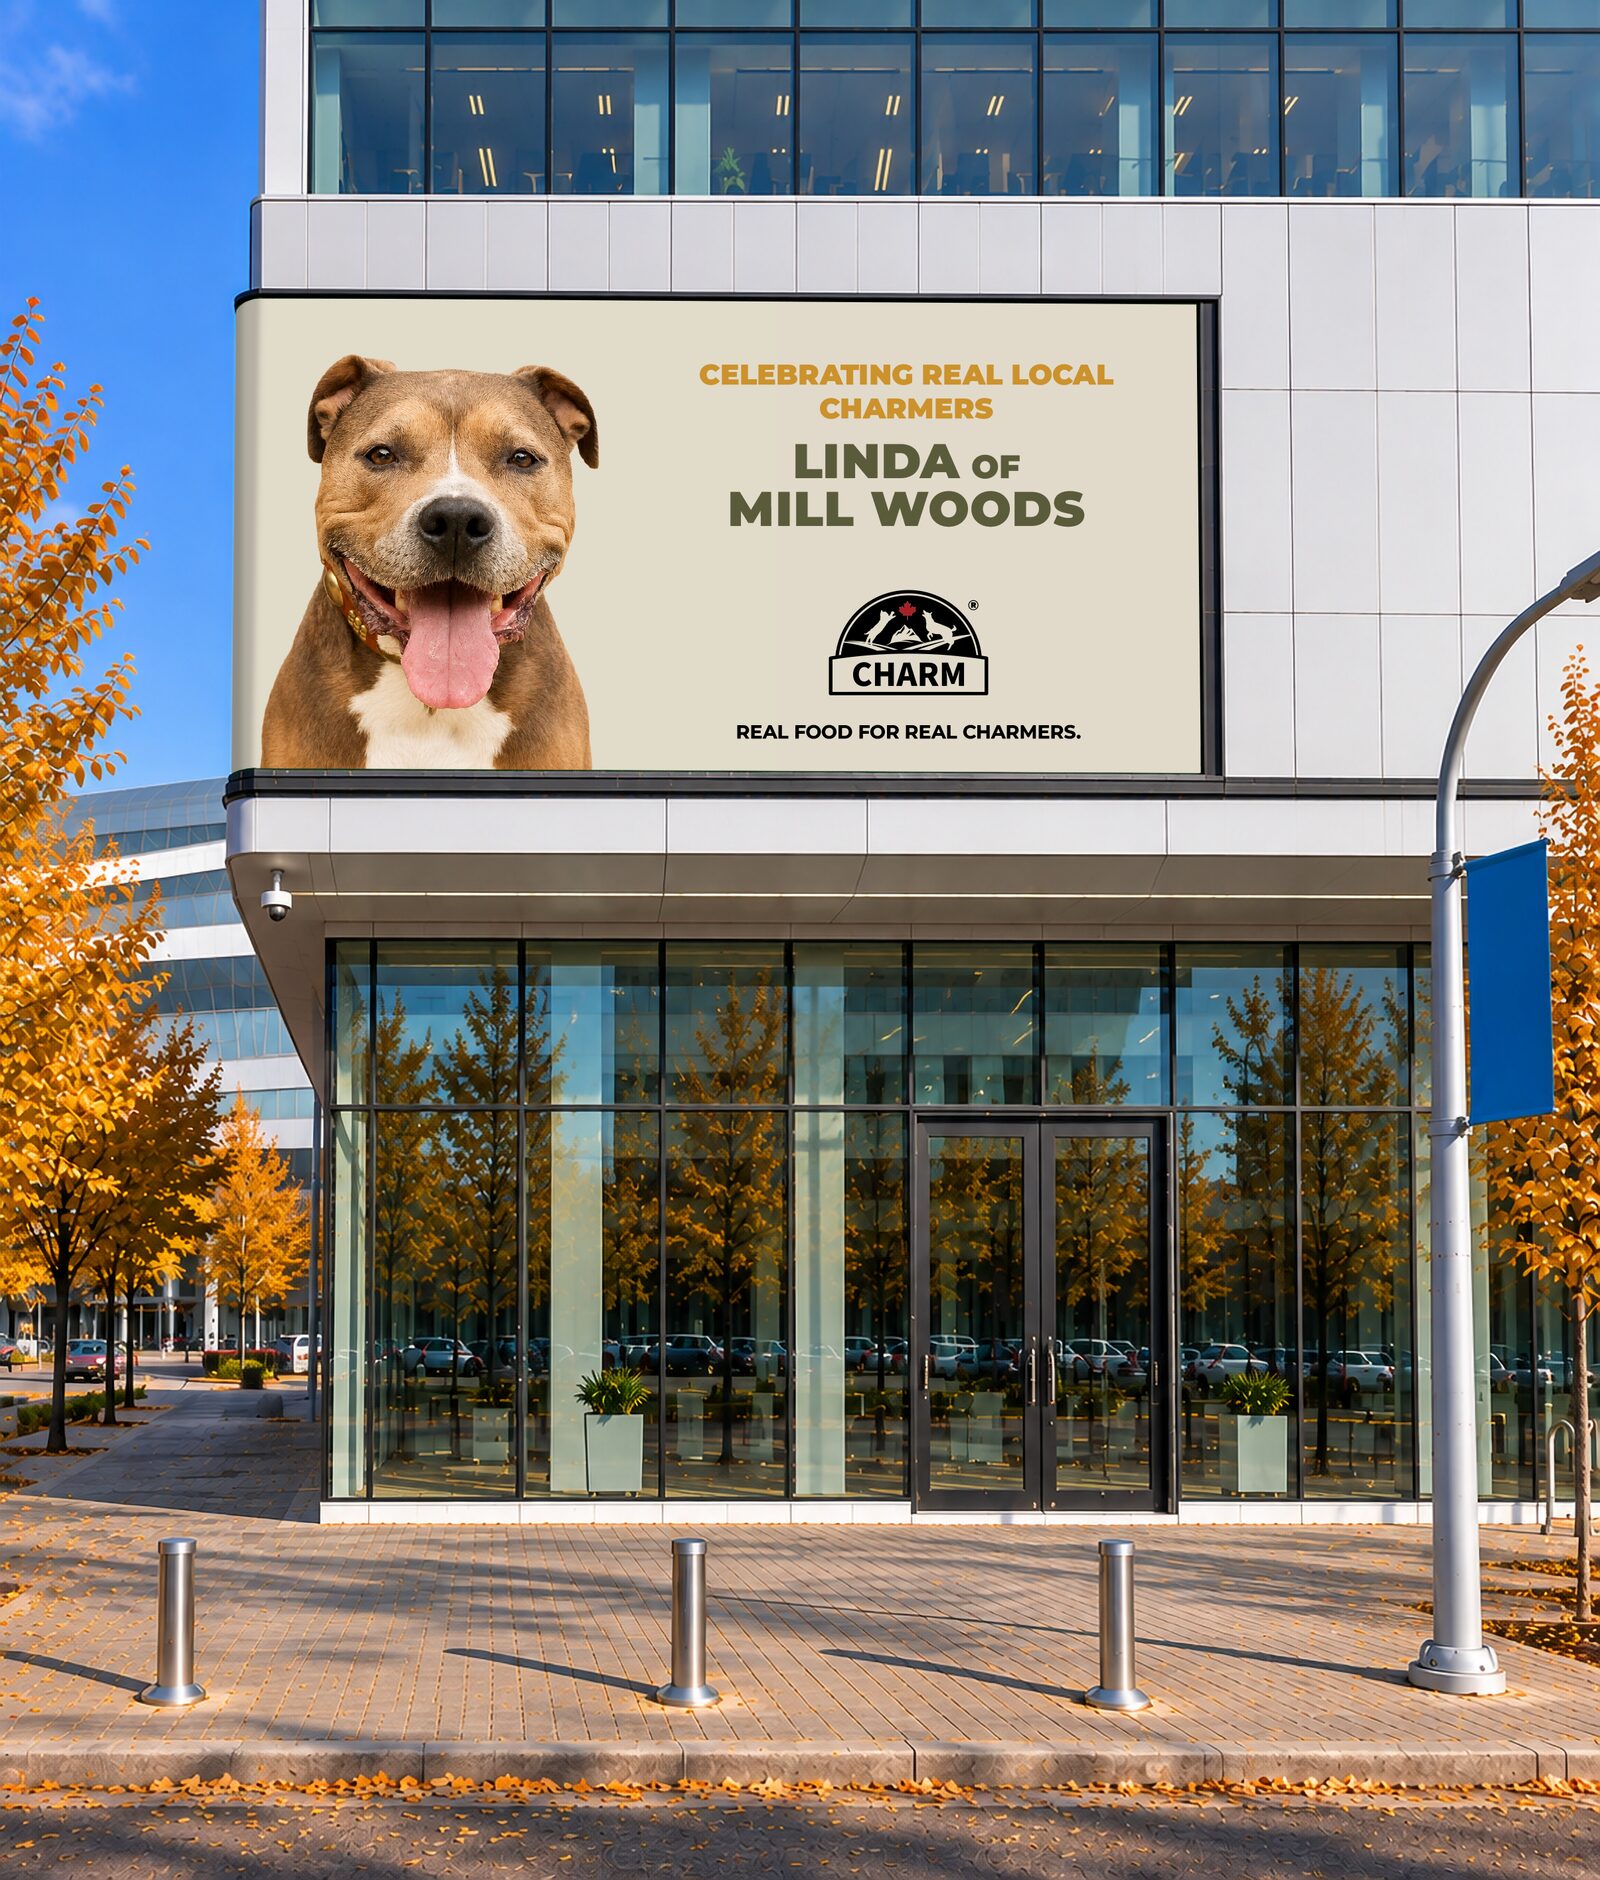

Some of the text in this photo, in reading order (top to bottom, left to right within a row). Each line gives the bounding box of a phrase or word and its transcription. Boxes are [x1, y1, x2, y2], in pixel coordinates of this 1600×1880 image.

[700, 364, 1115, 386] CELEBRATING REAL LOCAL
[819, 398, 994, 420] CHARMERS
[794, 443, 1021, 480] LINDA OF
[729, 490, 1086, 528] MILL WOODS
[852, 661, 966, 688] CHARM
[736, 724, 1082, 740] REAL FOOD FOR REAL CHARMERS.
